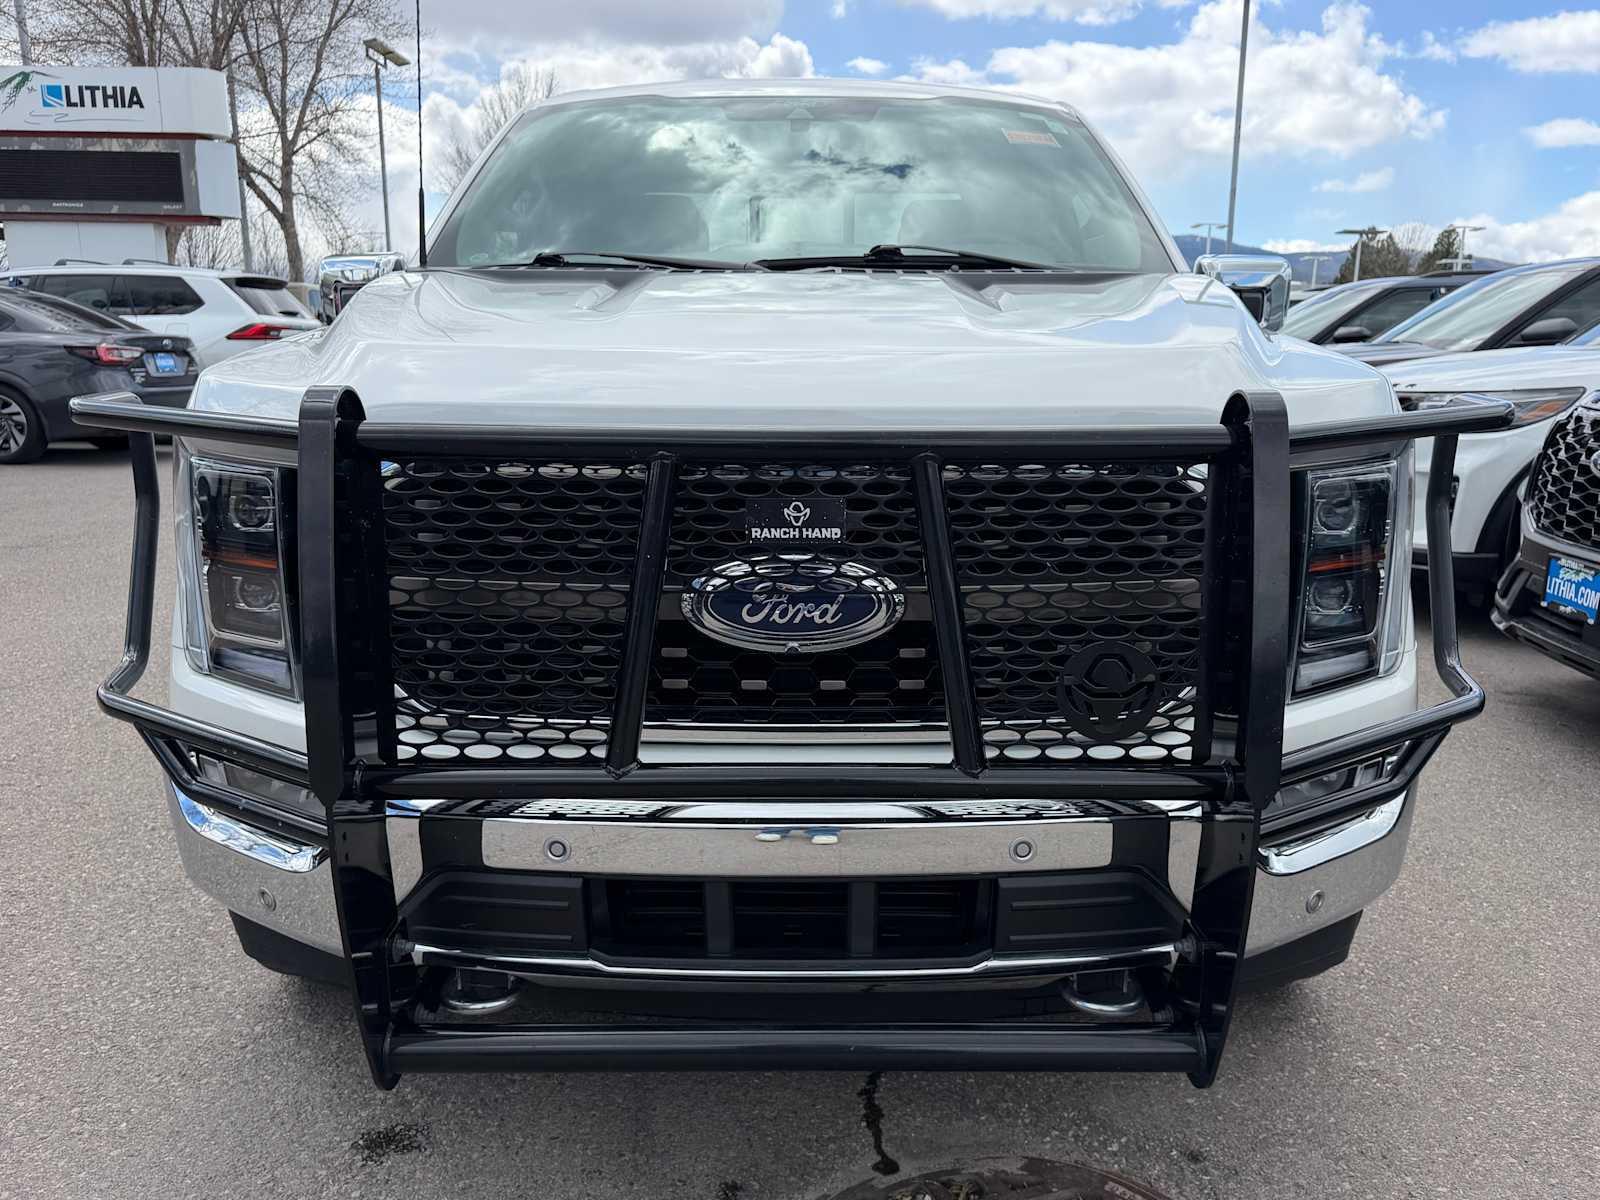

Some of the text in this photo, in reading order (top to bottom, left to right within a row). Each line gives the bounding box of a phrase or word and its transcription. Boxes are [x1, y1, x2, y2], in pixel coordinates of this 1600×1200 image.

[64, 85, 145, 109] LITHIA
[751, 528, 841, 539] RANCH HAND
[741, 583, 844, 624] Ford
[1546, 575, 1600, 610] LITHIA.COM
